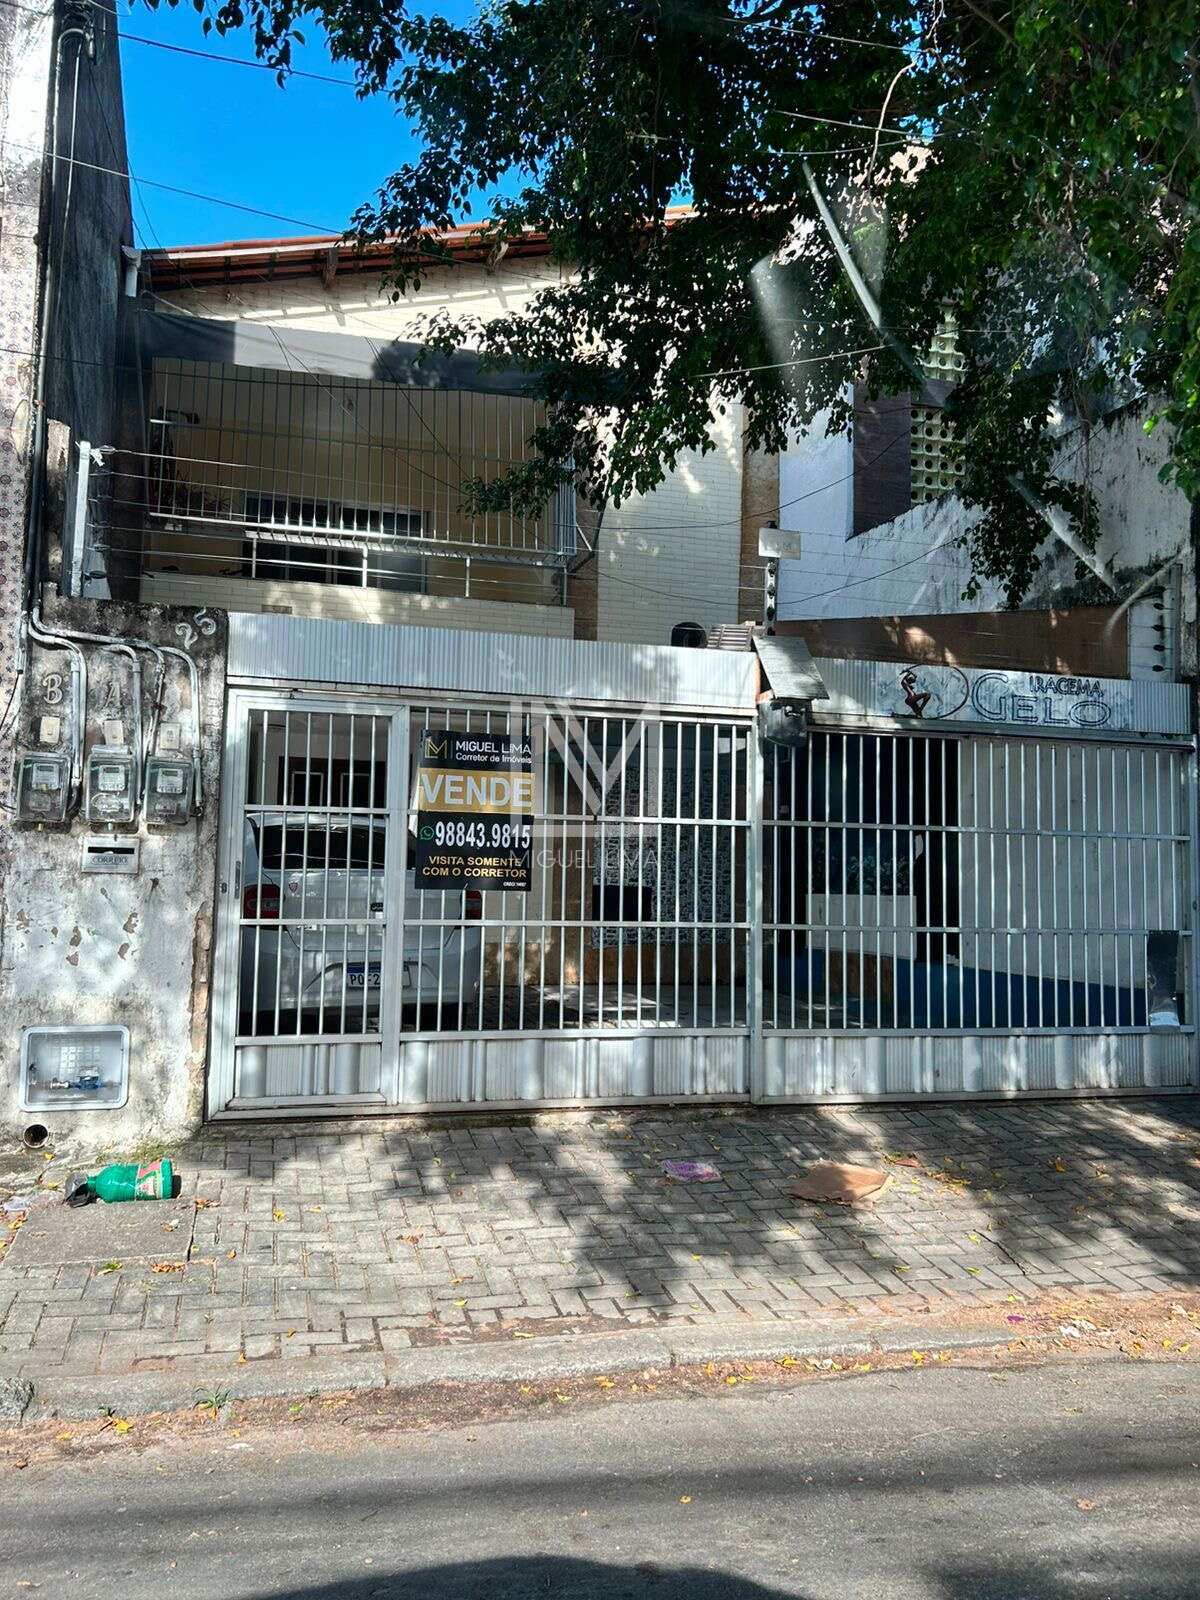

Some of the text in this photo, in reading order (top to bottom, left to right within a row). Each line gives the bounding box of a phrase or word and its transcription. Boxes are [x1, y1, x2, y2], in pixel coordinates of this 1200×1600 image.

[971, 672, 1112, 727] GELO
[455, 740, 532, 755] MIGUEL LIMA
[455, 752, 532, 764] Corretor de Imóveis
[421, 773, 532, 807] VENDE
[435, 821, 531, 849] 98843.9815
[428, 855, 522, 868] VISITA SOMENTE
[422, 866, 527, 878] COM O CORRETOR
